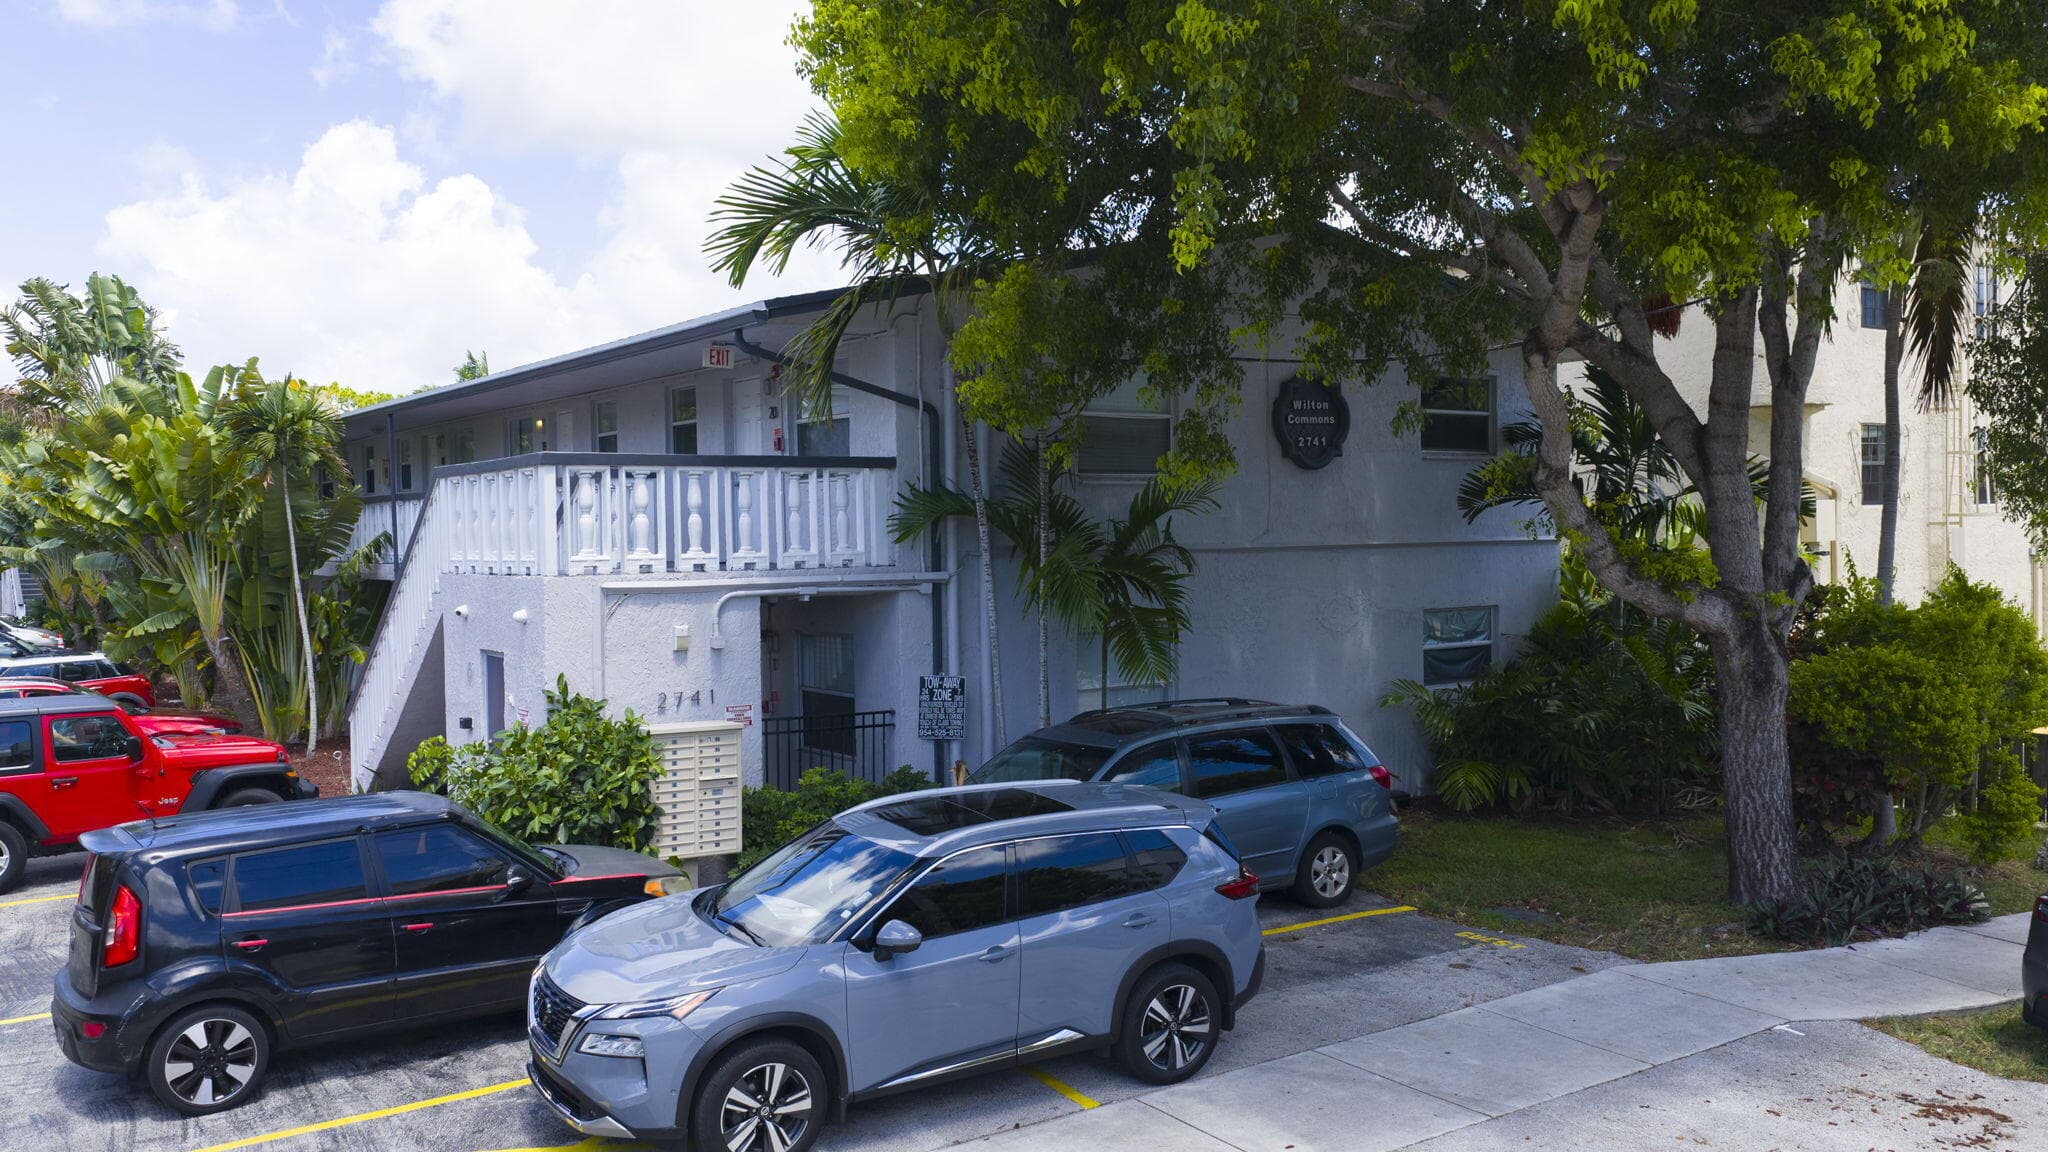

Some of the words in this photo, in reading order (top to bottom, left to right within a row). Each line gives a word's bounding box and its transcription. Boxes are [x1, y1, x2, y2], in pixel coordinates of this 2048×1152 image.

[709, 349, 730, 367] EXIT
[1293, 400, 1329, 409] Wilton
[1287, 414, 1335, 424] Commons
[1298, 437, 1326, 447] 2741
[658, 689, 714, 709] 2741
[933, 689, 952, 701] ZONE
[158, 797, 178, 805] Jeep
[1455, 931, 1528, 949] GUEST
